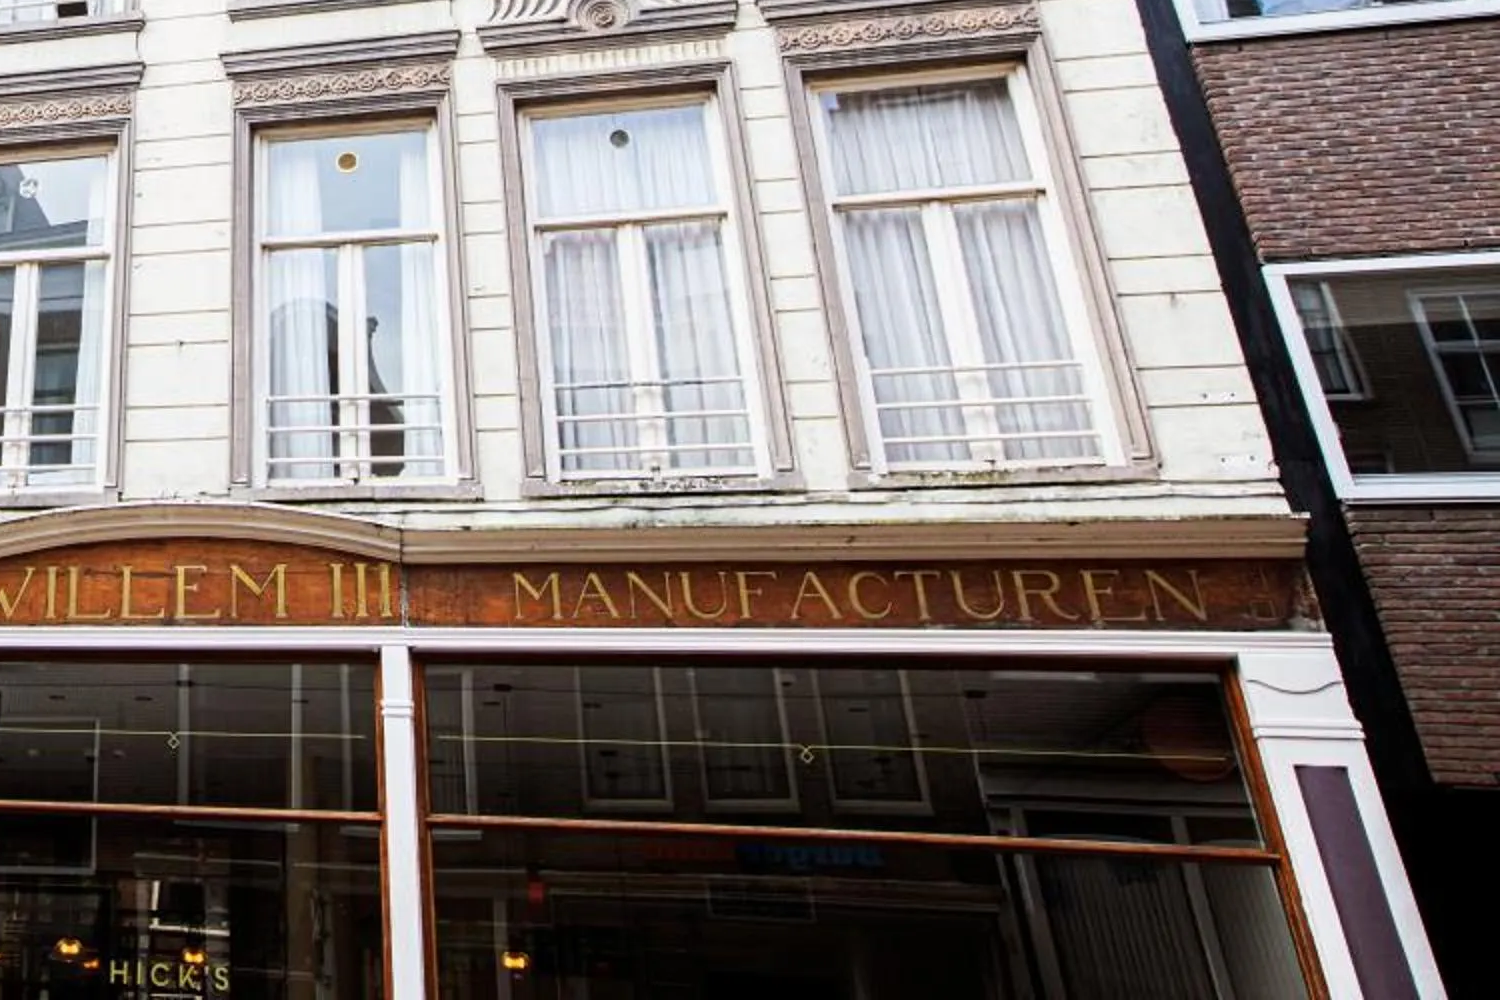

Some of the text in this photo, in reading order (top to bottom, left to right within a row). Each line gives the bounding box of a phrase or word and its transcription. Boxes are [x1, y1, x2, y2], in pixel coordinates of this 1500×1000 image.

[329, 562, 392, 618] III
[512, 569, 1208, 621] MANUFACTUREN
[109, 959, 229, 991] HICK'S
